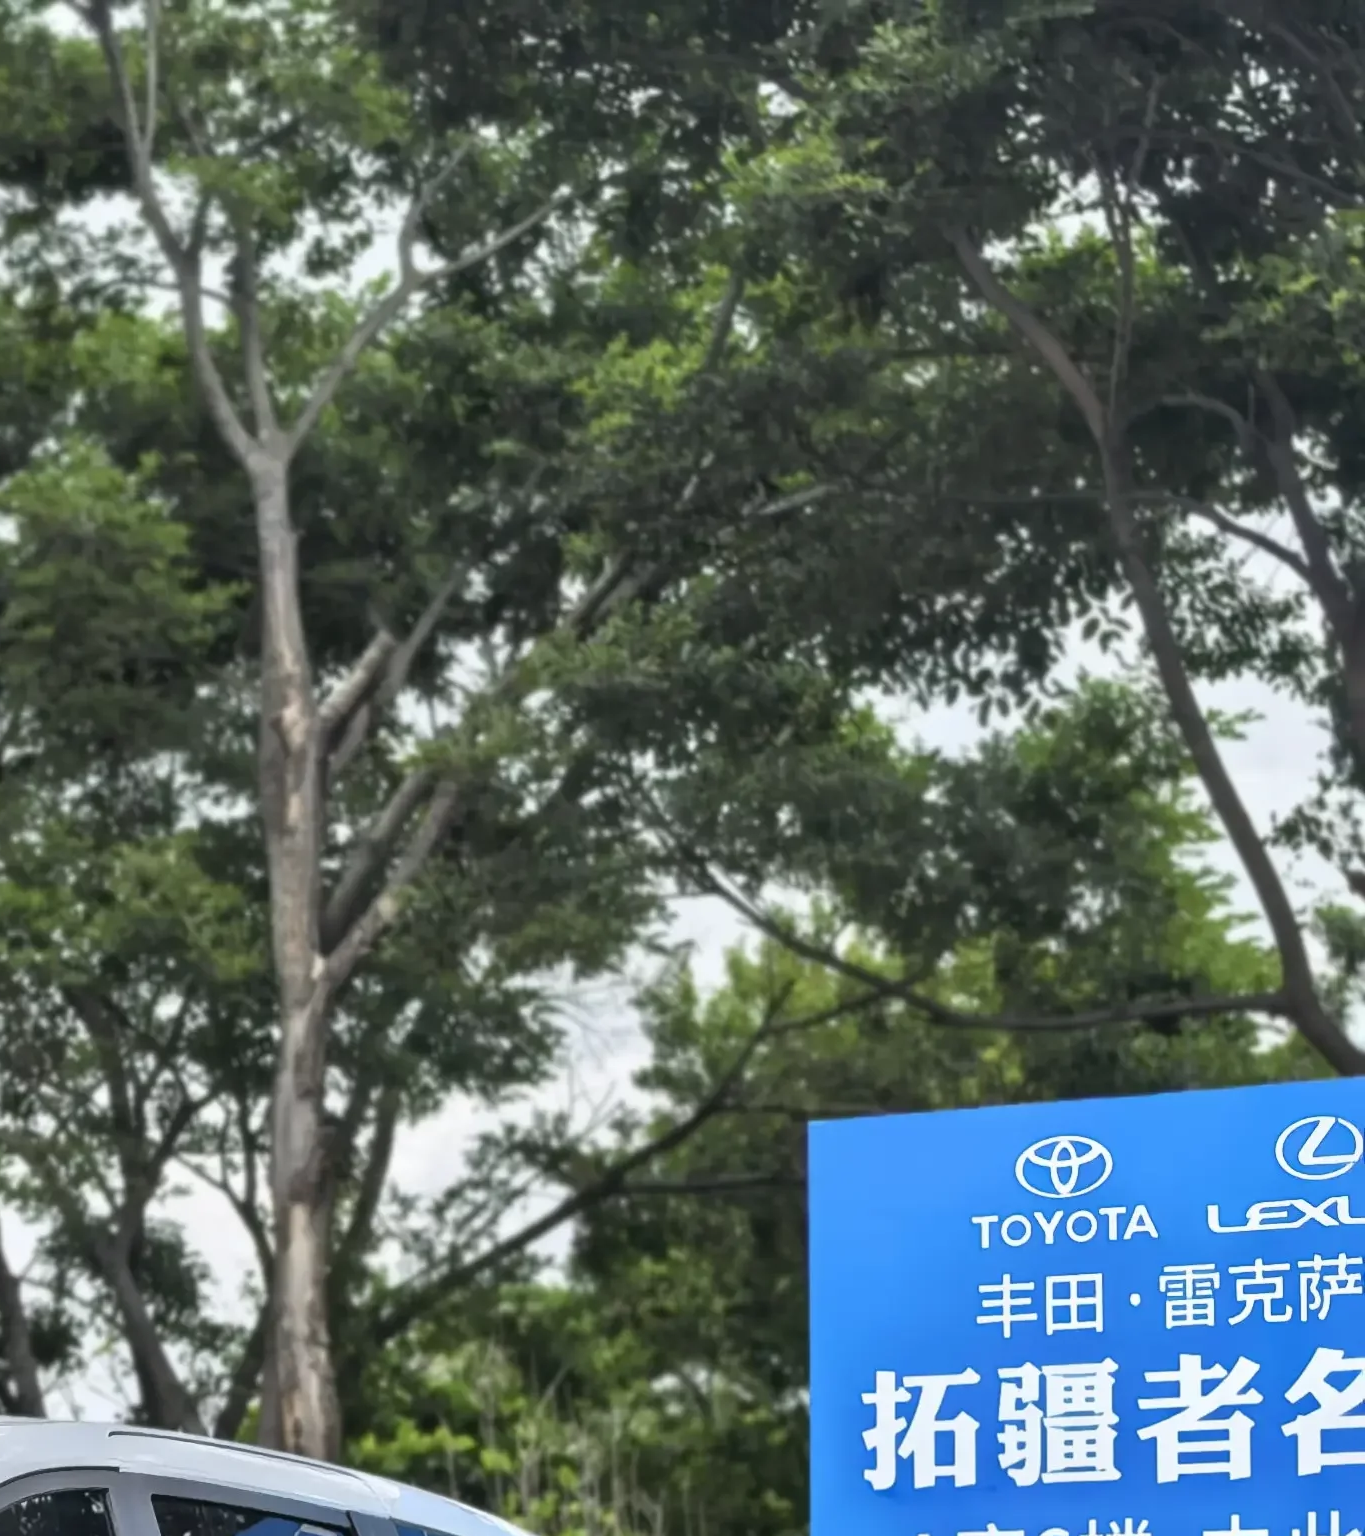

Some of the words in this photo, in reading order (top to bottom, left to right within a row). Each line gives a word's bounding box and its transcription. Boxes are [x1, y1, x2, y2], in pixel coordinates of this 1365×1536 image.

[972, 1204, 1158, 1248] TOYOTA
[861, 1347, 1365, 1491] 拓疆者名
